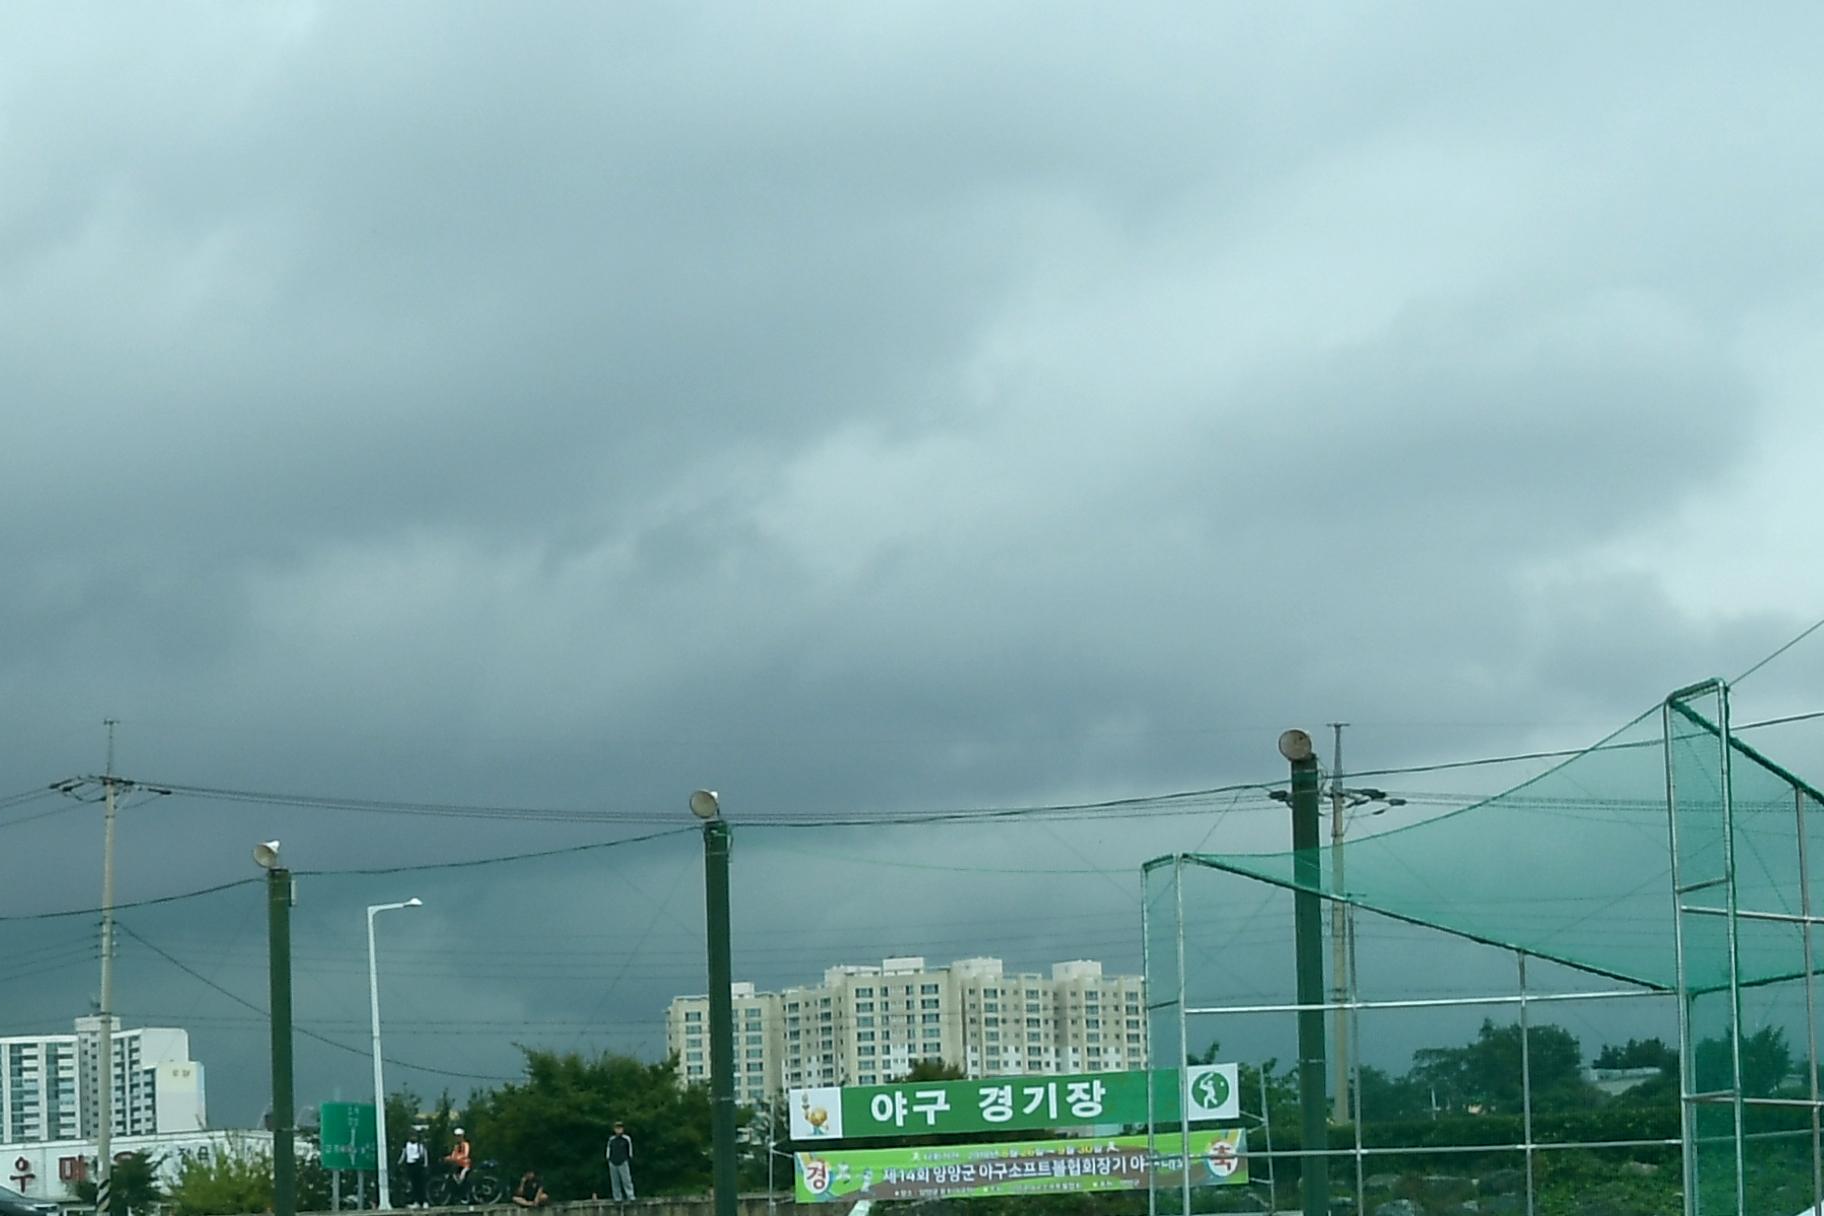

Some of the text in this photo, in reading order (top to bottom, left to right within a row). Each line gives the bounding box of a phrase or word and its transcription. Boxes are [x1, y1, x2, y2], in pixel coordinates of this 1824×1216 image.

[870, 1080, 1106, 1127] 야구 경기장
[806, 1159, 827, 1190] 경
[883, 1167, 929, 1185] 제14회
[933, 1164, 976, 1184] 양양군
